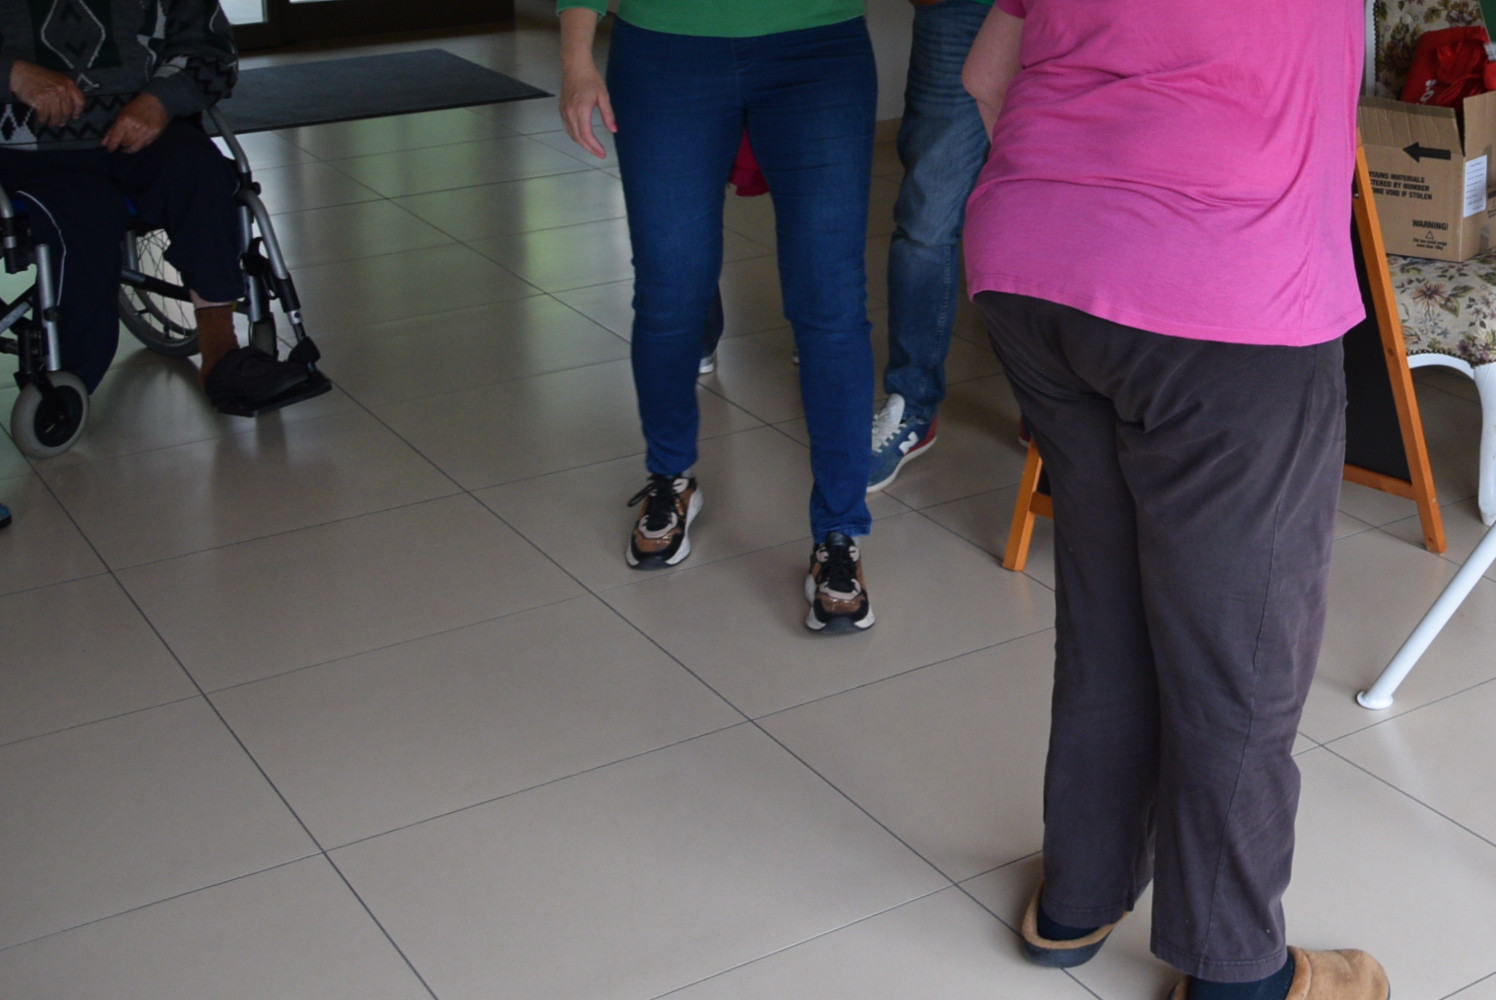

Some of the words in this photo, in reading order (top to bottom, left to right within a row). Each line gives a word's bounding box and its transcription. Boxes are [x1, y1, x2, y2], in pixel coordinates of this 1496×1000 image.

[1390, 173, 1425, 184] MATERIALS
[1393, 181, 1402, 189] BY
[1386, 188, 1400, 197] VOID
[1409, 191, 1433, 201] STOLEN
[1412, 219, 1449, 231] WARNING!
